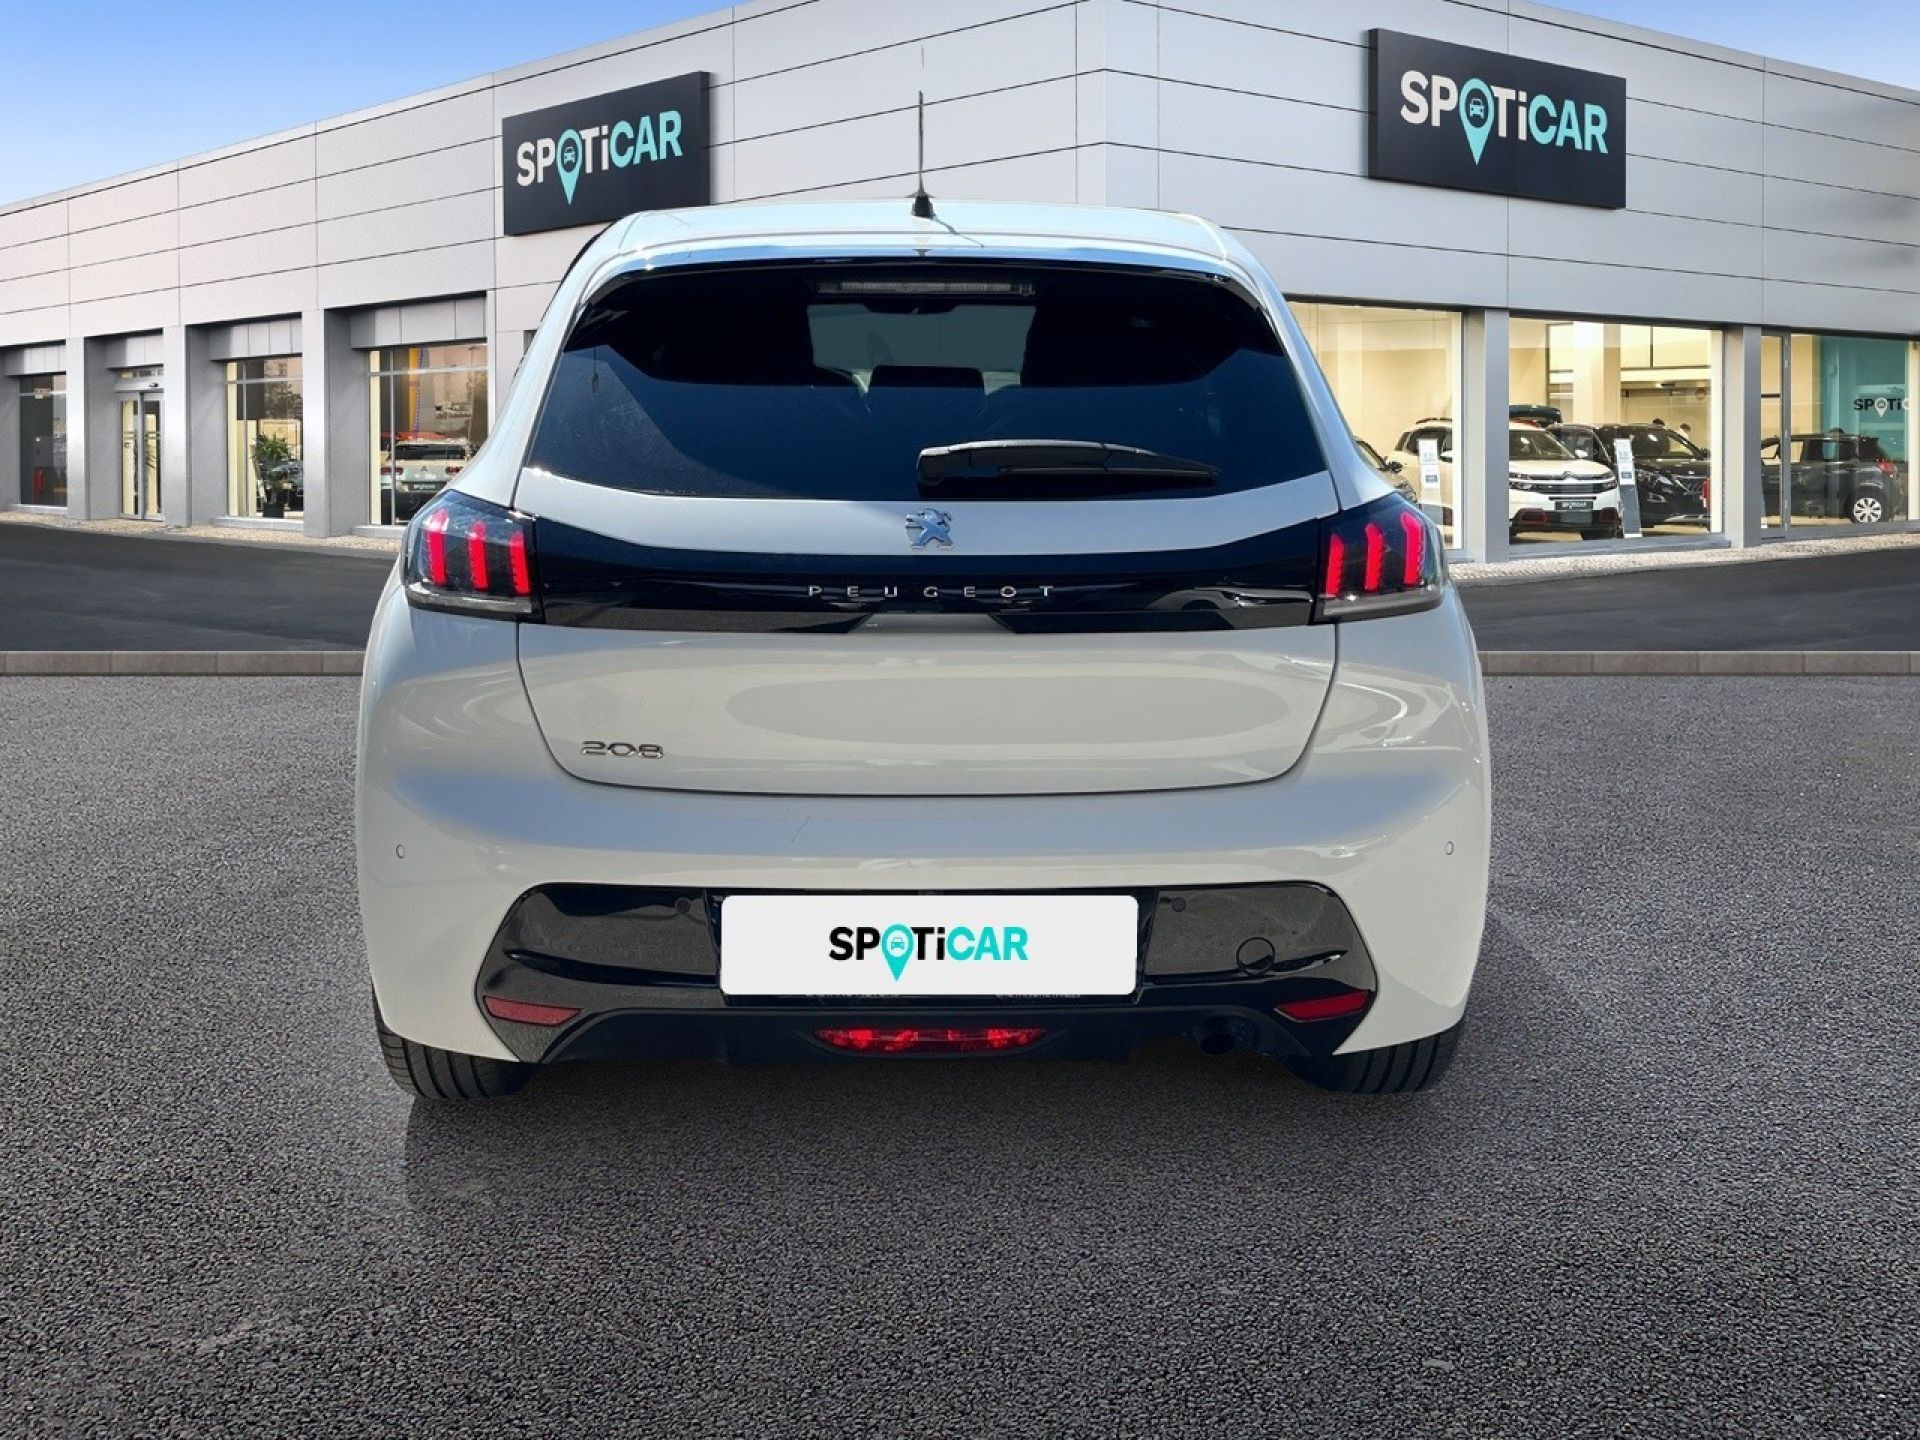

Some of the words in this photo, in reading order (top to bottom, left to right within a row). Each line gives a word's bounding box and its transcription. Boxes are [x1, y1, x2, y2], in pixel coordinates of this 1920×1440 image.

[1400, 70, 1609, 165] SPOTiCAR
[516, 110, 683, 205] SPOTiCAR
[808, 585, 1054, 598] PEUGEOT
[581, 741, 664, 759] 208
[828, 923, 1029, 982] SPOTiCAR
